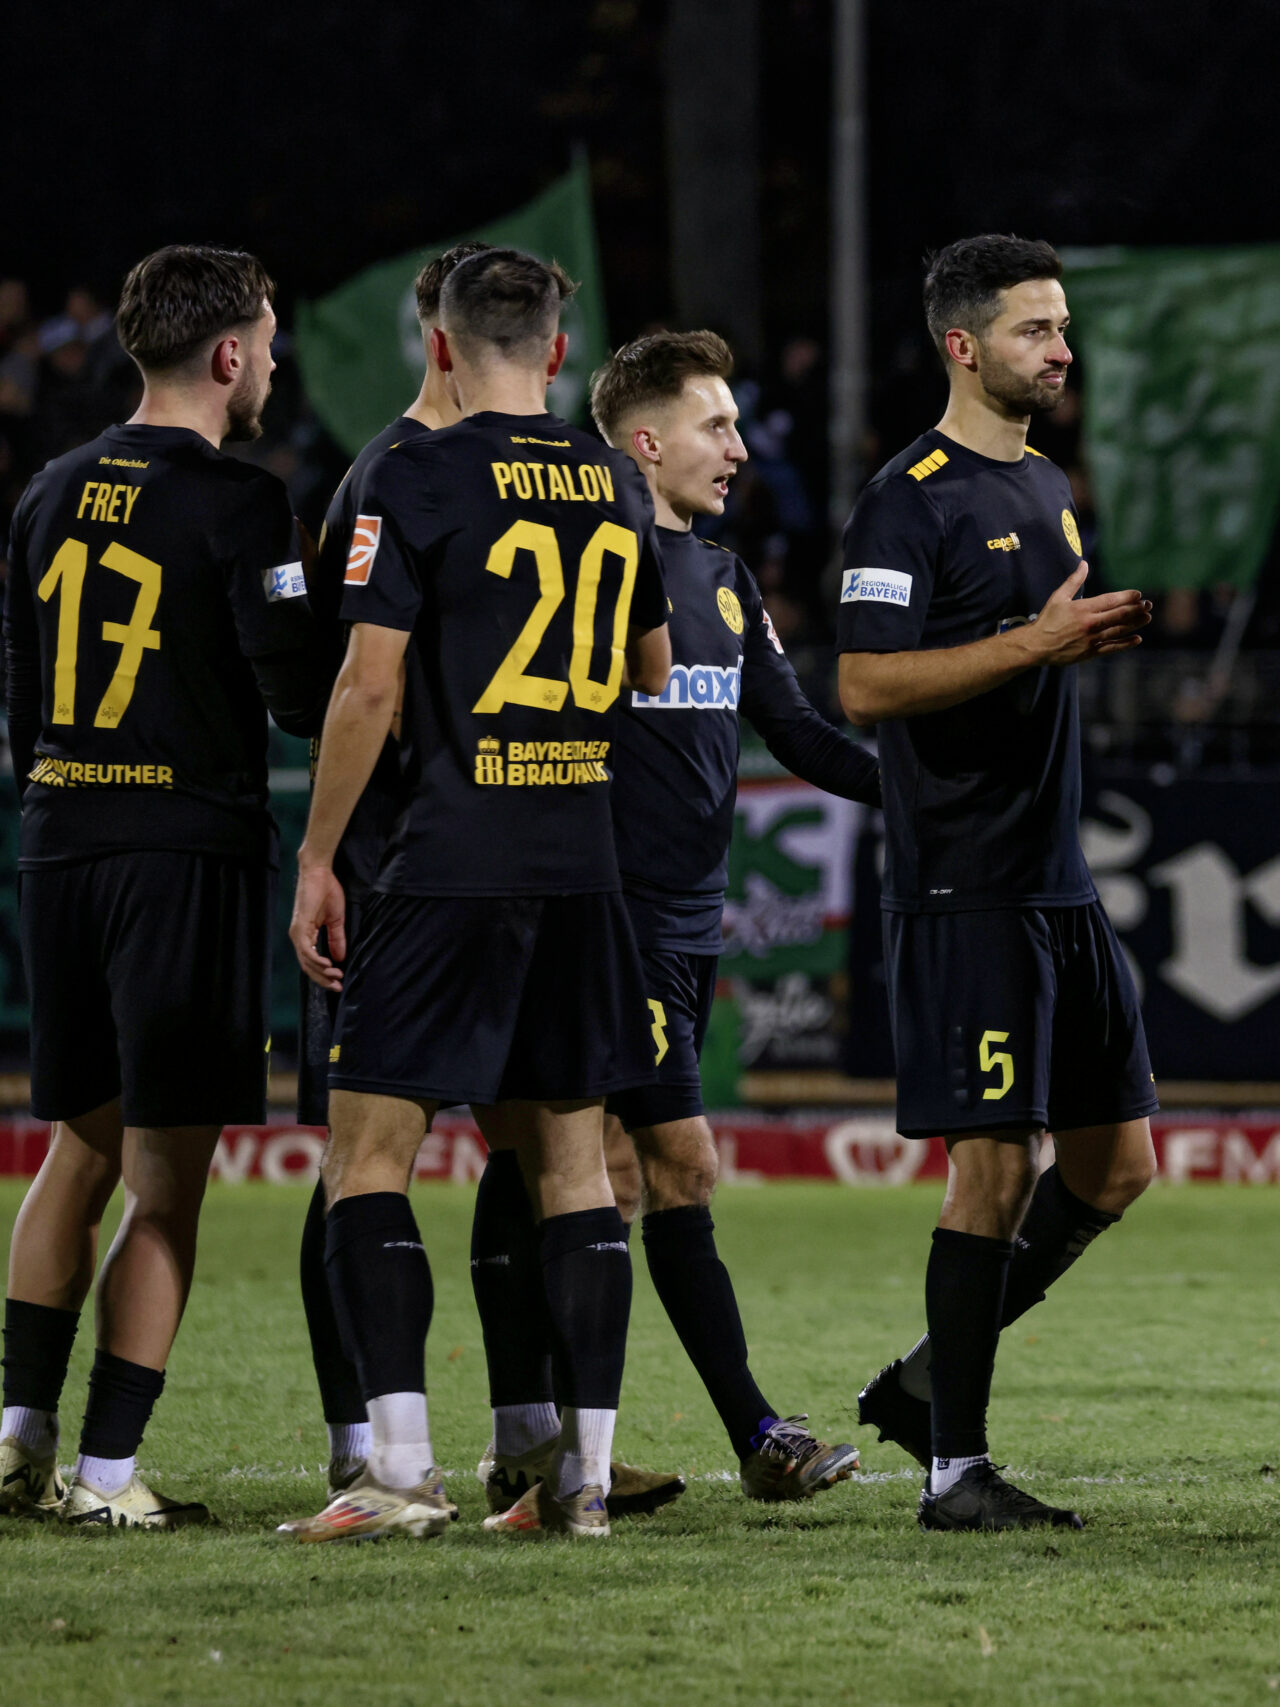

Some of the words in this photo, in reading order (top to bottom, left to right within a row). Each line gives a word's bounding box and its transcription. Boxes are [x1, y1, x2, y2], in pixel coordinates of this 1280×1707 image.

[76, 481, 142, 524] FREY
[490, 461, 615, 502] POTALOV
[860, 586, 908, 603] BAYERN
[861, 580, 908, 592] REGIONALLIGA
[38, 537, 162, 728] 17
[471, 519, 638, 714] 20
[978, 1030, 1015, 1100] 5
